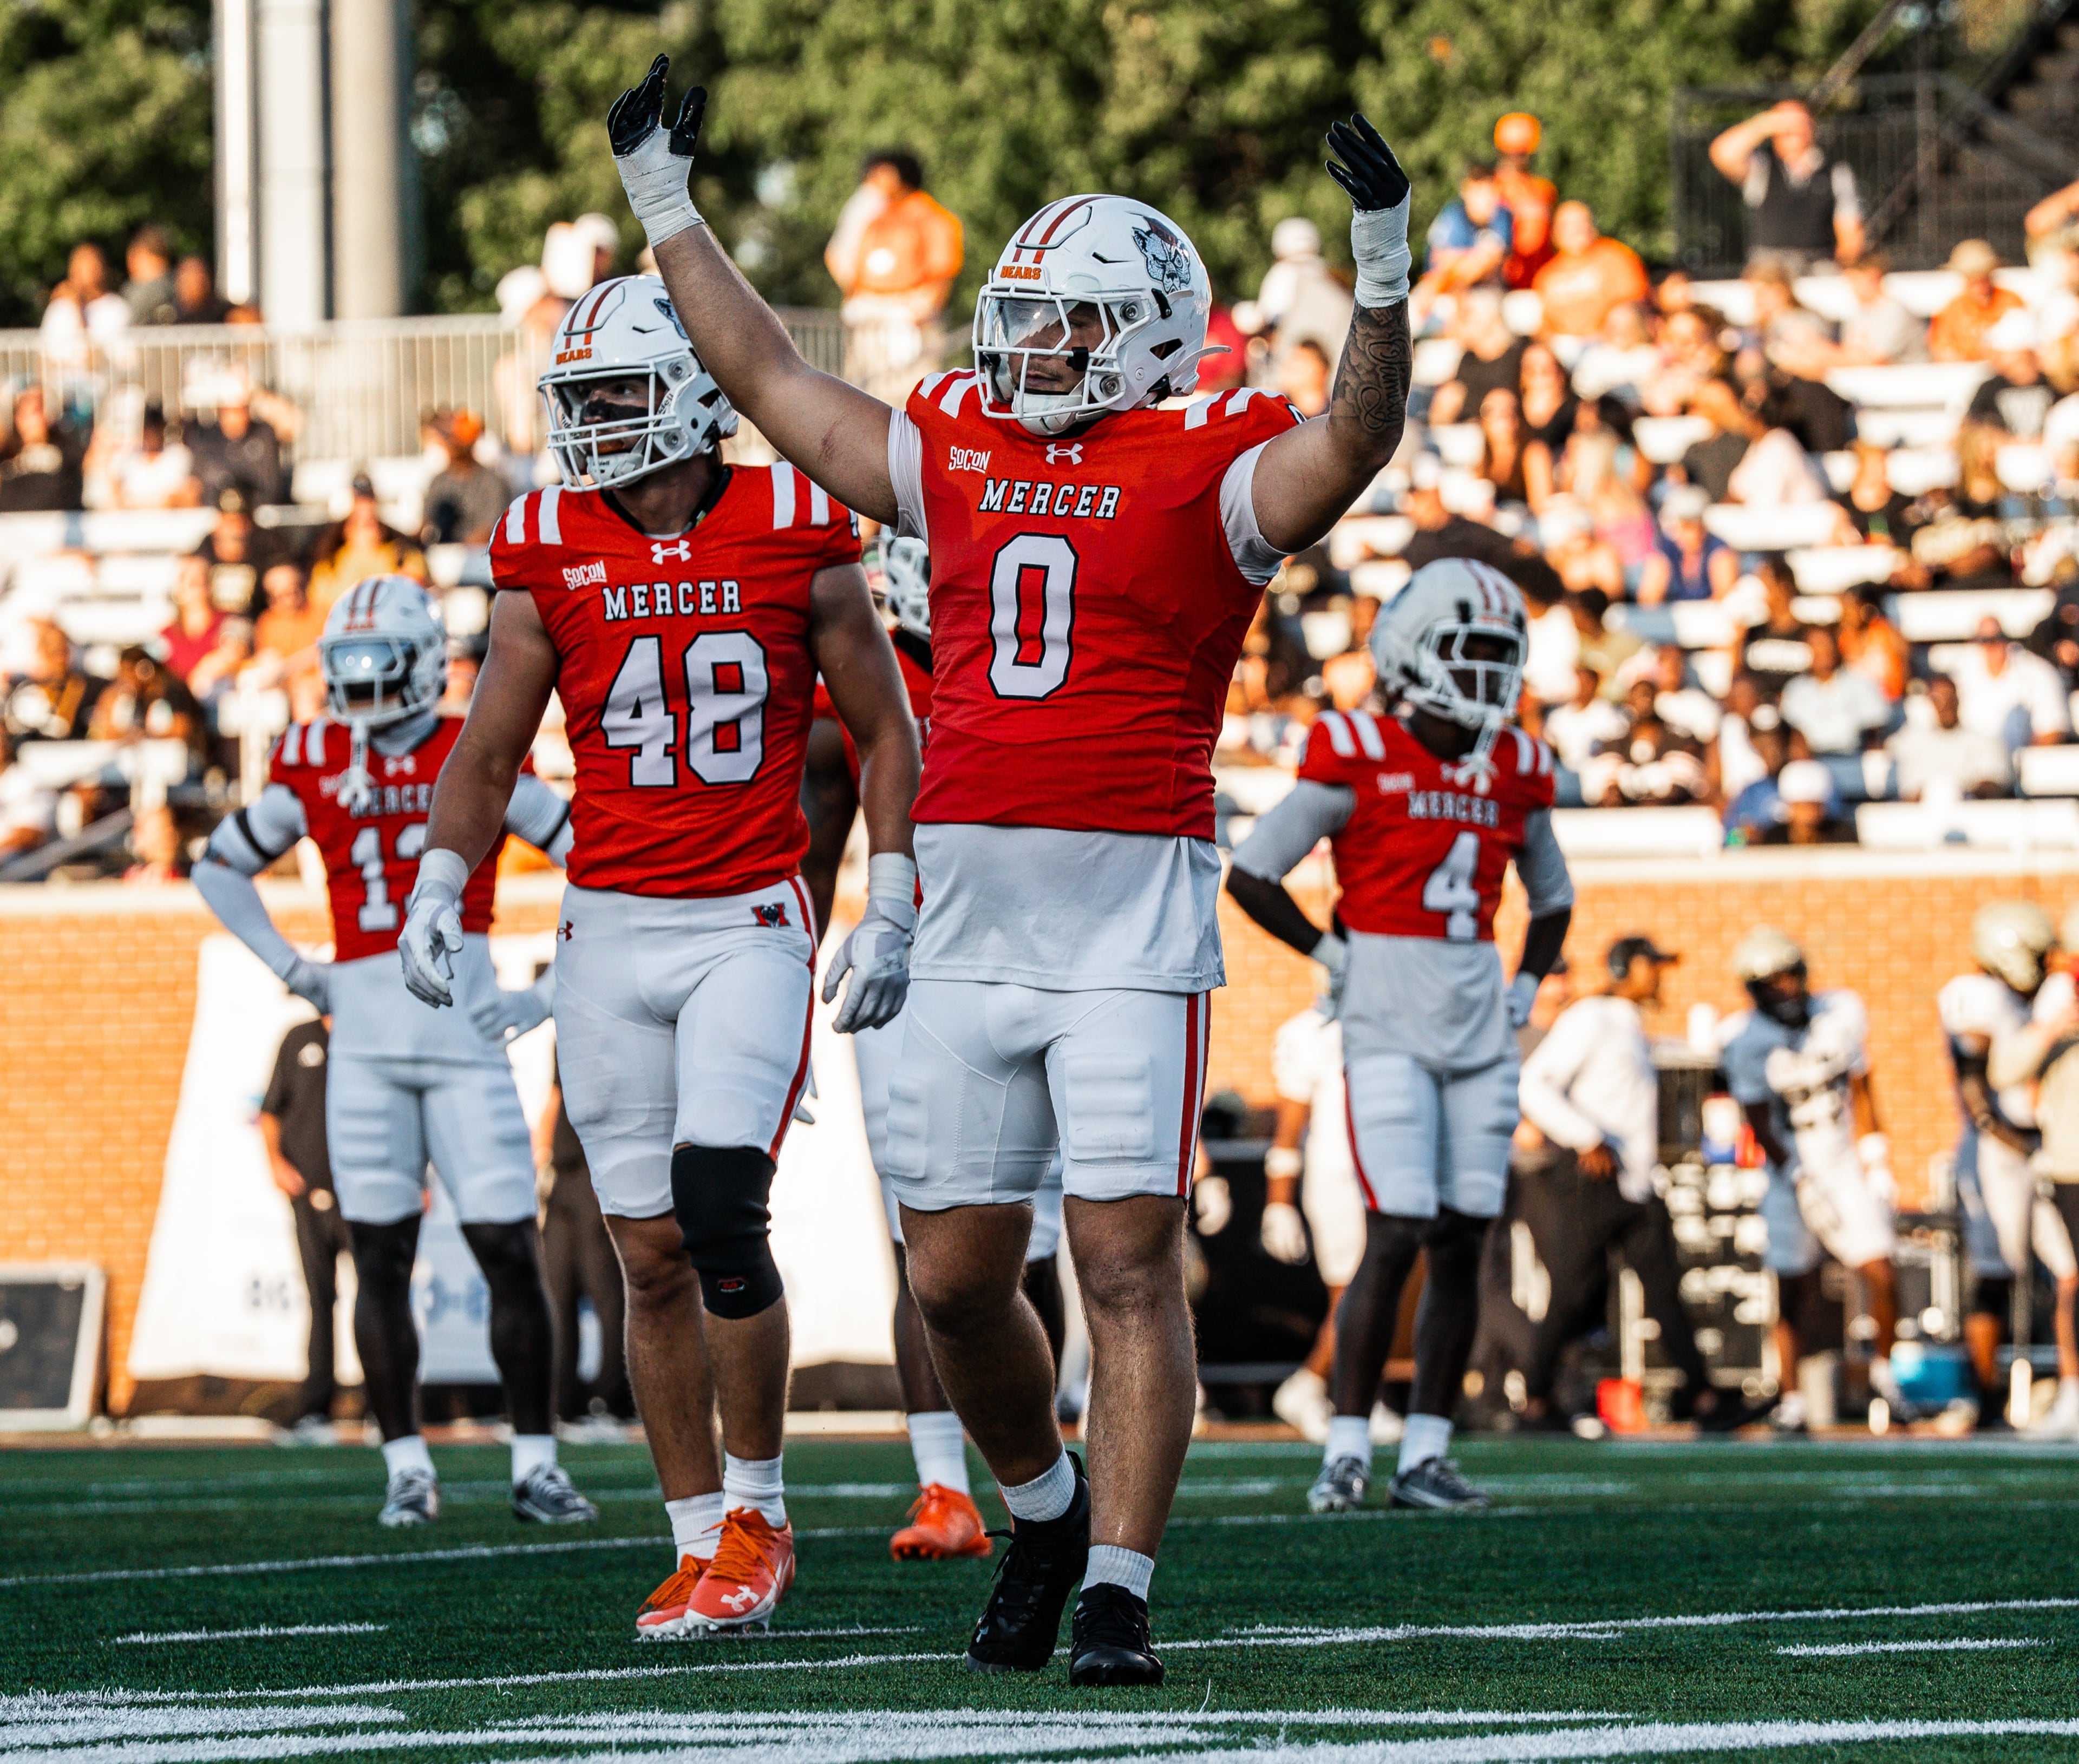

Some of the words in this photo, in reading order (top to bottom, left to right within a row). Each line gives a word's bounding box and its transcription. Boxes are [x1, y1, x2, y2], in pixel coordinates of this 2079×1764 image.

[1000, 265, 1042, 280] BEARS
[556, 347, 592, 365] BEARS
[978, 478, 1122, 520] MERCER
[602, 579, 742, 621] MERCER
[987, 532, 1079, 701] 0
[601, 629, 770, 788] 48
[1422, 830, 1480, 942] 4
